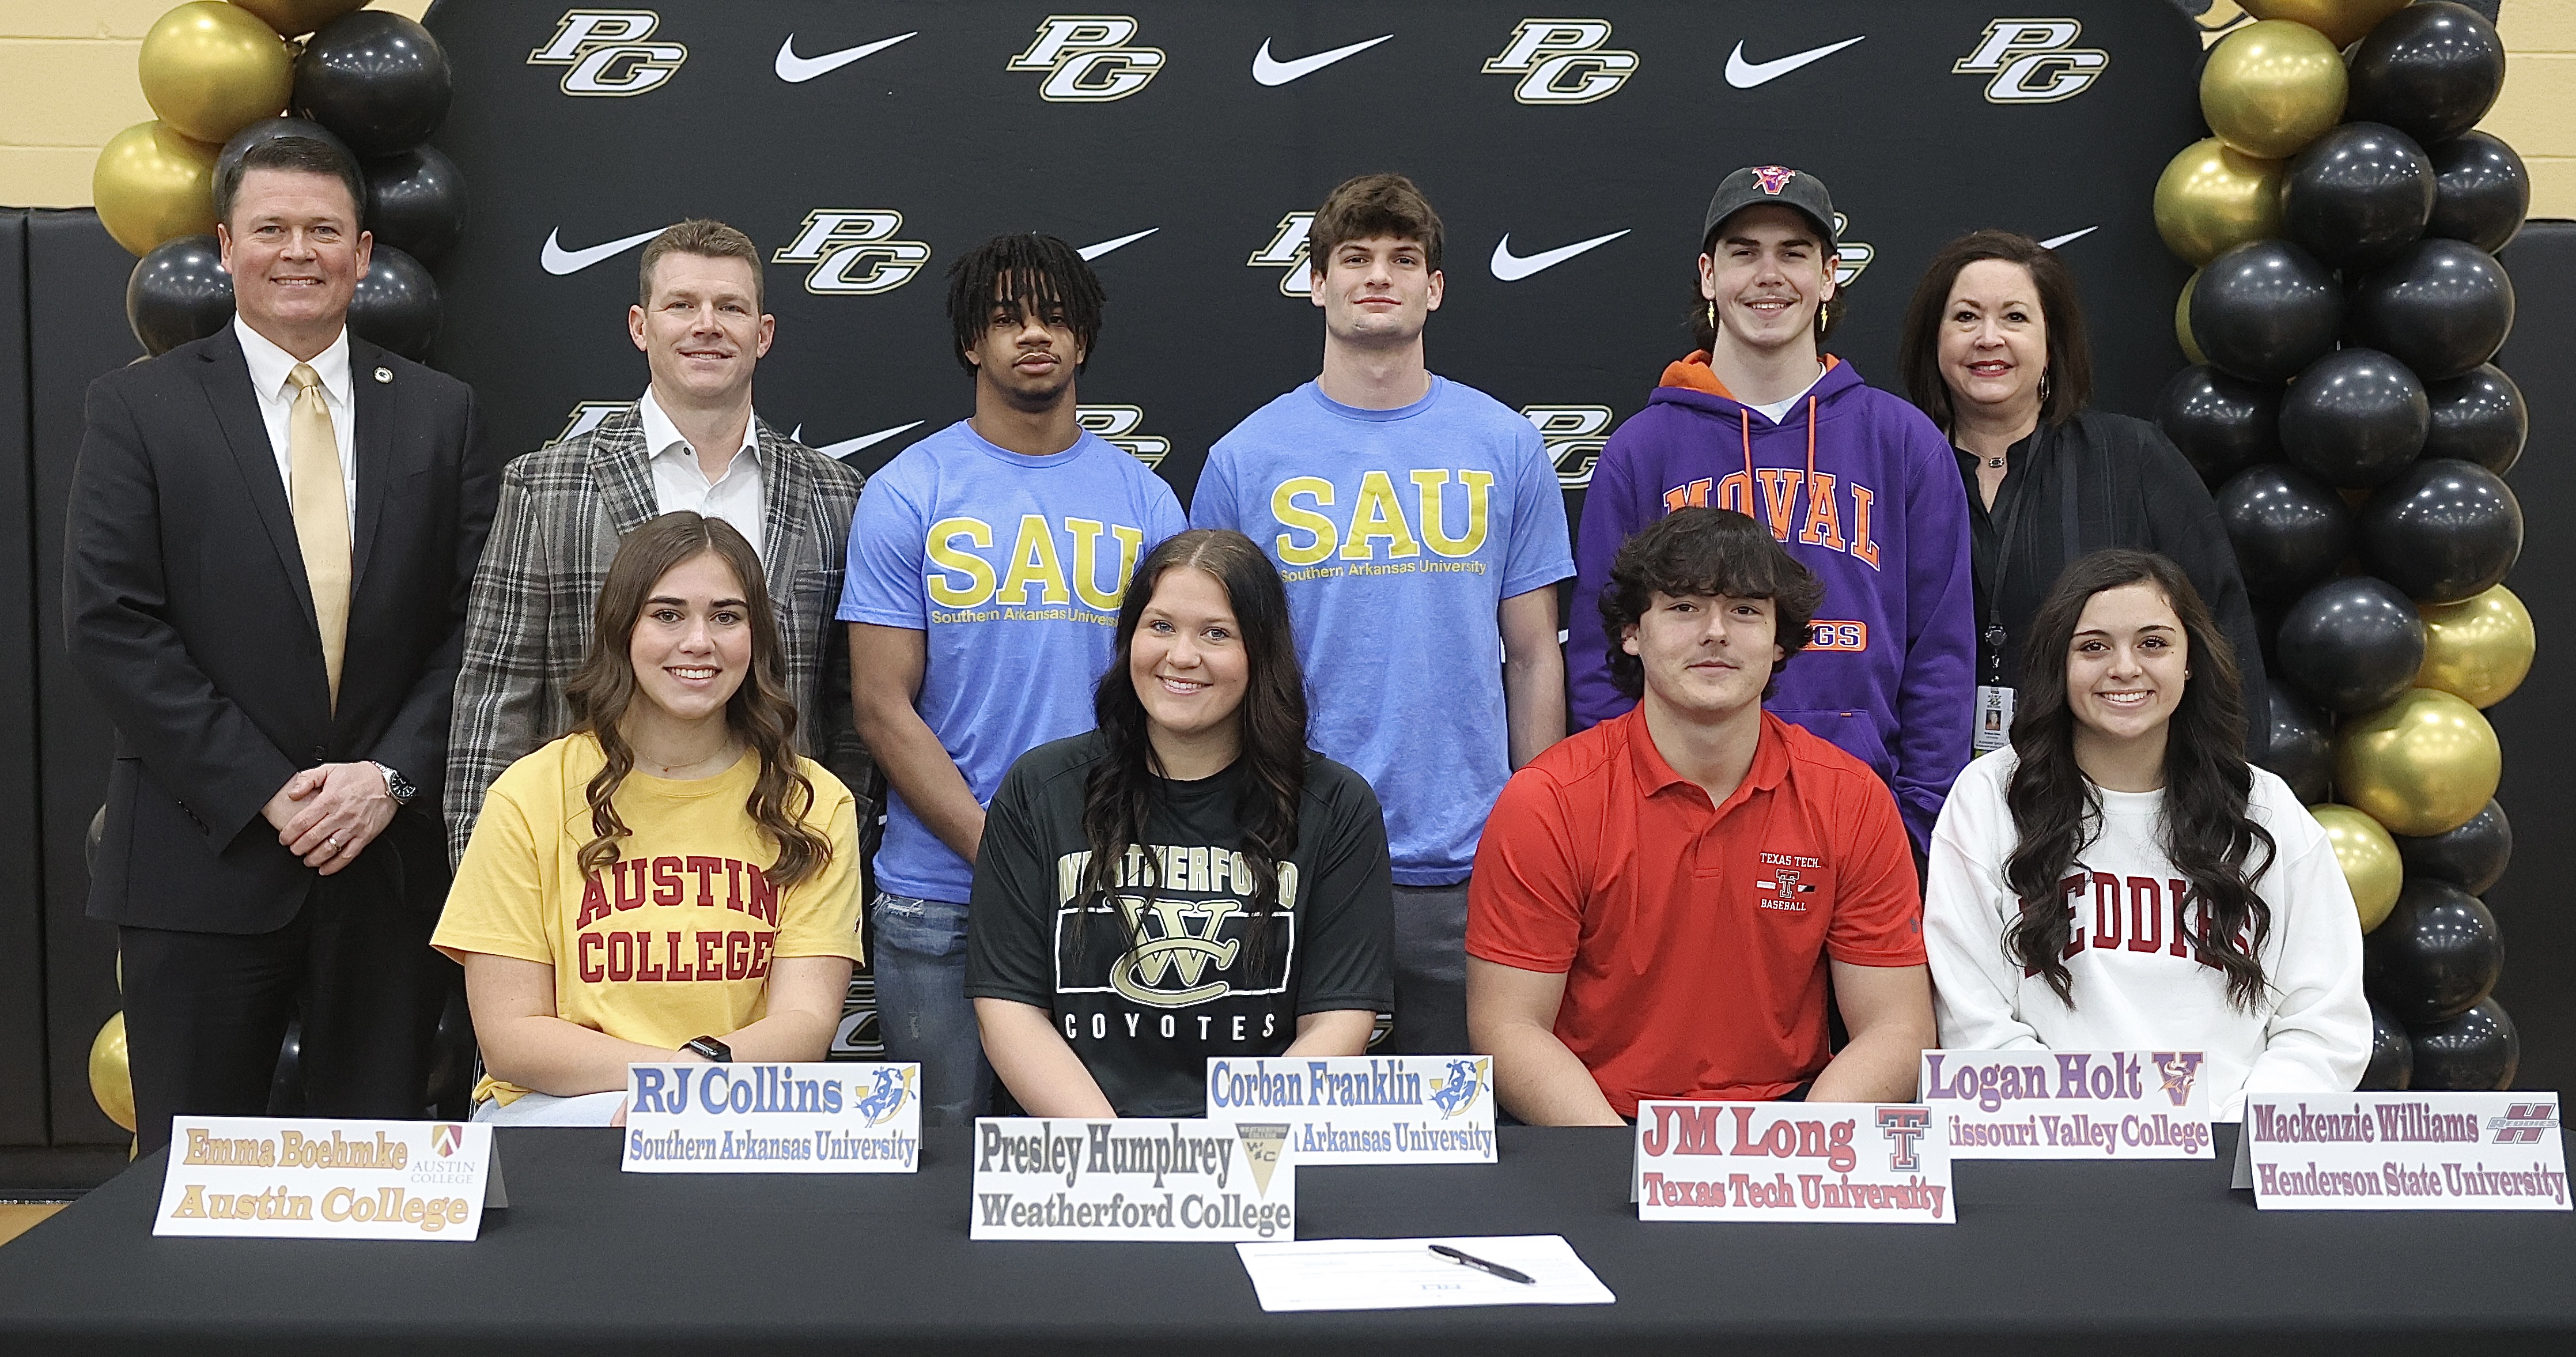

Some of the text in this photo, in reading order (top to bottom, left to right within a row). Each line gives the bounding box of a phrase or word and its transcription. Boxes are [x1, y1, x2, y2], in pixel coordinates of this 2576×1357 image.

[527, 9, 688, 97] PG
[1006, 14, 1167, 102] PG
[1481, 17, 1640, 105] PG
[1951, 18, 2110, 104] PG
[771, 208, 931, 295] PG
[1270, 468, 1495, 566] SAU
[925, 514, 1143, 611] SAU
[1281, 560, 1487, 583] Southern Arkansas University
[932, 609, 1000, 624] Southern
[1004, 607, 1067, 621] Arkansas
[1058, 843, 1298, 910] WTHERFOD
[1760, 852, 1821, 868] TEXAS TECH
[576, 856, 780, 931] AUSTIN
[1761, 898, 1806, 911] BASEBALL
[578, 931, 776, 983] COLLEGE
[1064, 1012, 1275, 1040] COYOTES
[631, 1065, 843, 1114] RJ Collins
[1211, 1060, 1424, 1107] Corban Franklin
[1925, 1052, 2143, 1113] Logan Holt
[1303, 1122, 1391, 1152] Arkansas
[1393, 1121, 1493, 1158] University
[1642, 1106, 1856, 1173] JM Long
[1949, 1113, 2210, 1155] issouri Valley College
[2252, 1102, 2479, 1144] Mackenzie Williams
[2486, 1117, 2559, 1129] REDDIES
[183, 1128, 408, 1170] Emma Boehmke
[412, 1161, 475, 1172] AUSTIN
[629, 1128, 917, 1169] Southern Arkansas University
[979, 1121, 1235, 1189] Presley Humphrey
[411, 1173, 474, 1184] COLLEGE
[1643, 1172, 1946, 1219] Texas Tech University
[2256, 1161, 2566, 1205] Henderson State University
[171, 1185, 470, 1232] Austin College
[978, 1192, 1291, 1238] Weatherford College
